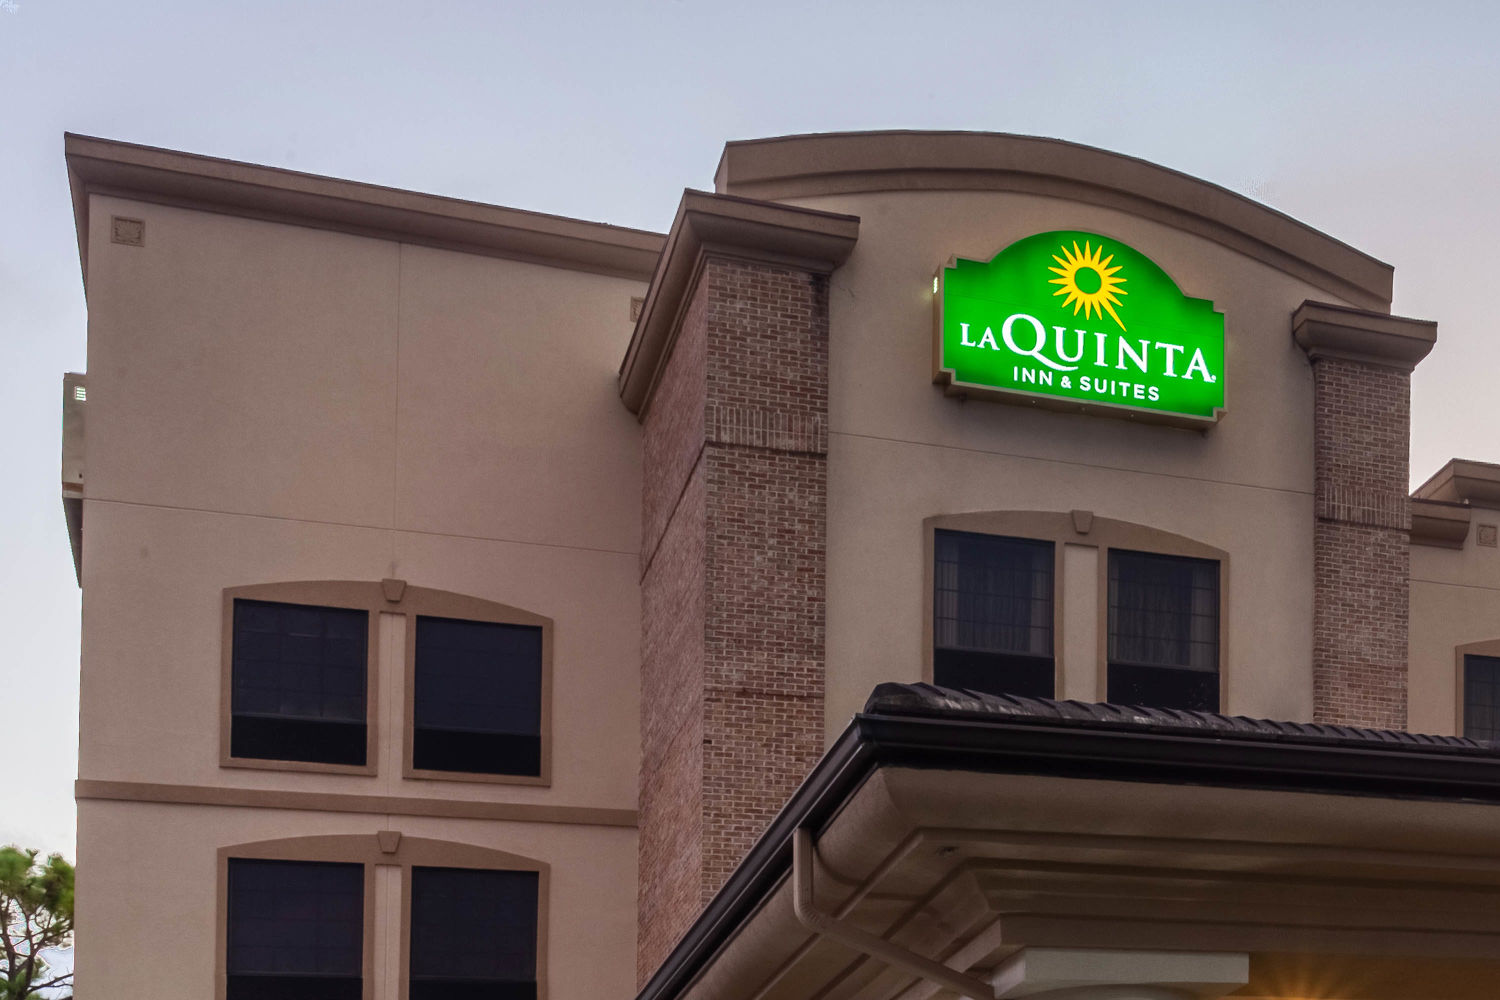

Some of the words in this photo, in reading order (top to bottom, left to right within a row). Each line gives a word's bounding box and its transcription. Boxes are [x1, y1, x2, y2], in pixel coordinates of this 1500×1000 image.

[1002, 313, 1217, 383] QUINTA
[1013, 365, 1053, 387] INN
[1060, 375, 1072, 389] &
[1079, 375, 1160, 401] SUITES
